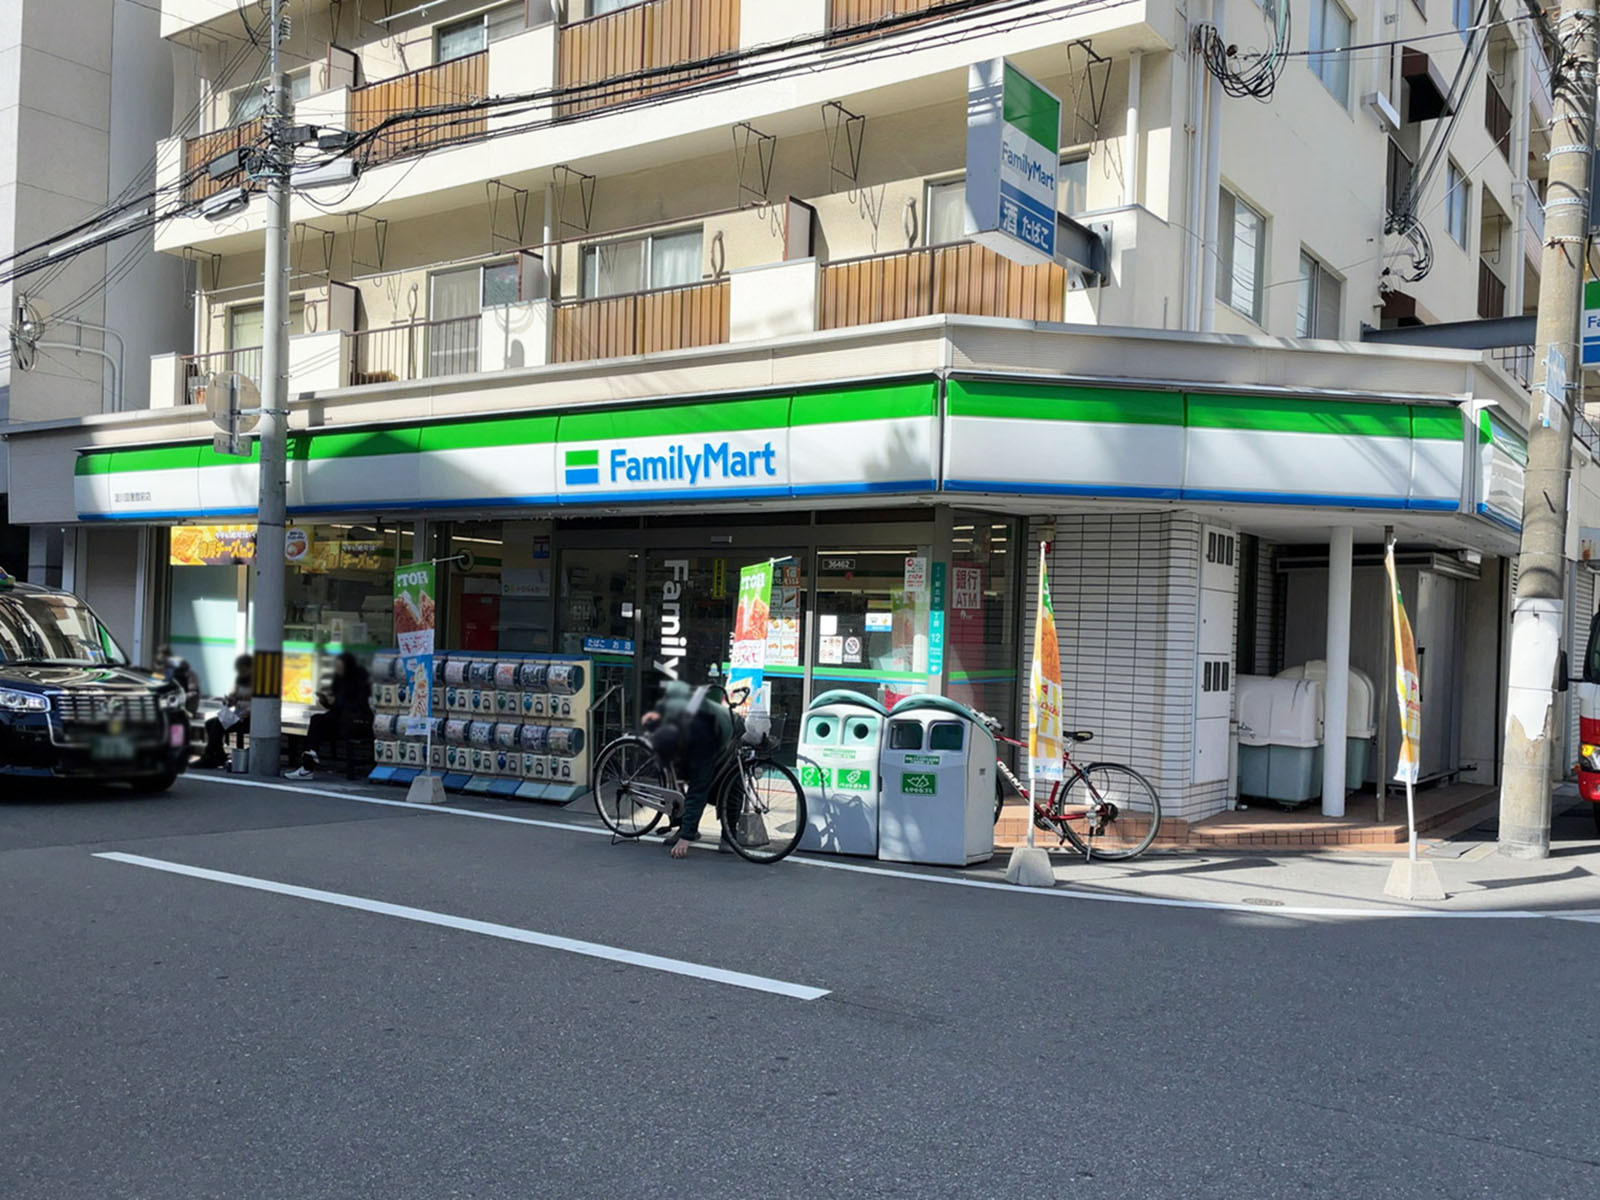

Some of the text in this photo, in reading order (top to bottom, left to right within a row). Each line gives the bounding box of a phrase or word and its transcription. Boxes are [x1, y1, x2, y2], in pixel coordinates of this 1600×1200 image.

[1001, 141, 1054, 191] FamilyMart
[1003, 200, 1049, 249] 酒 たばこ
[610, 442, 776, 485] FamilyMart
[955, 570, 979, 591] 銀行
[956, 592, 978, 609] ATM
[930, 632, 941, 644] 12
[996, 760, 1027, 792] GIANT
